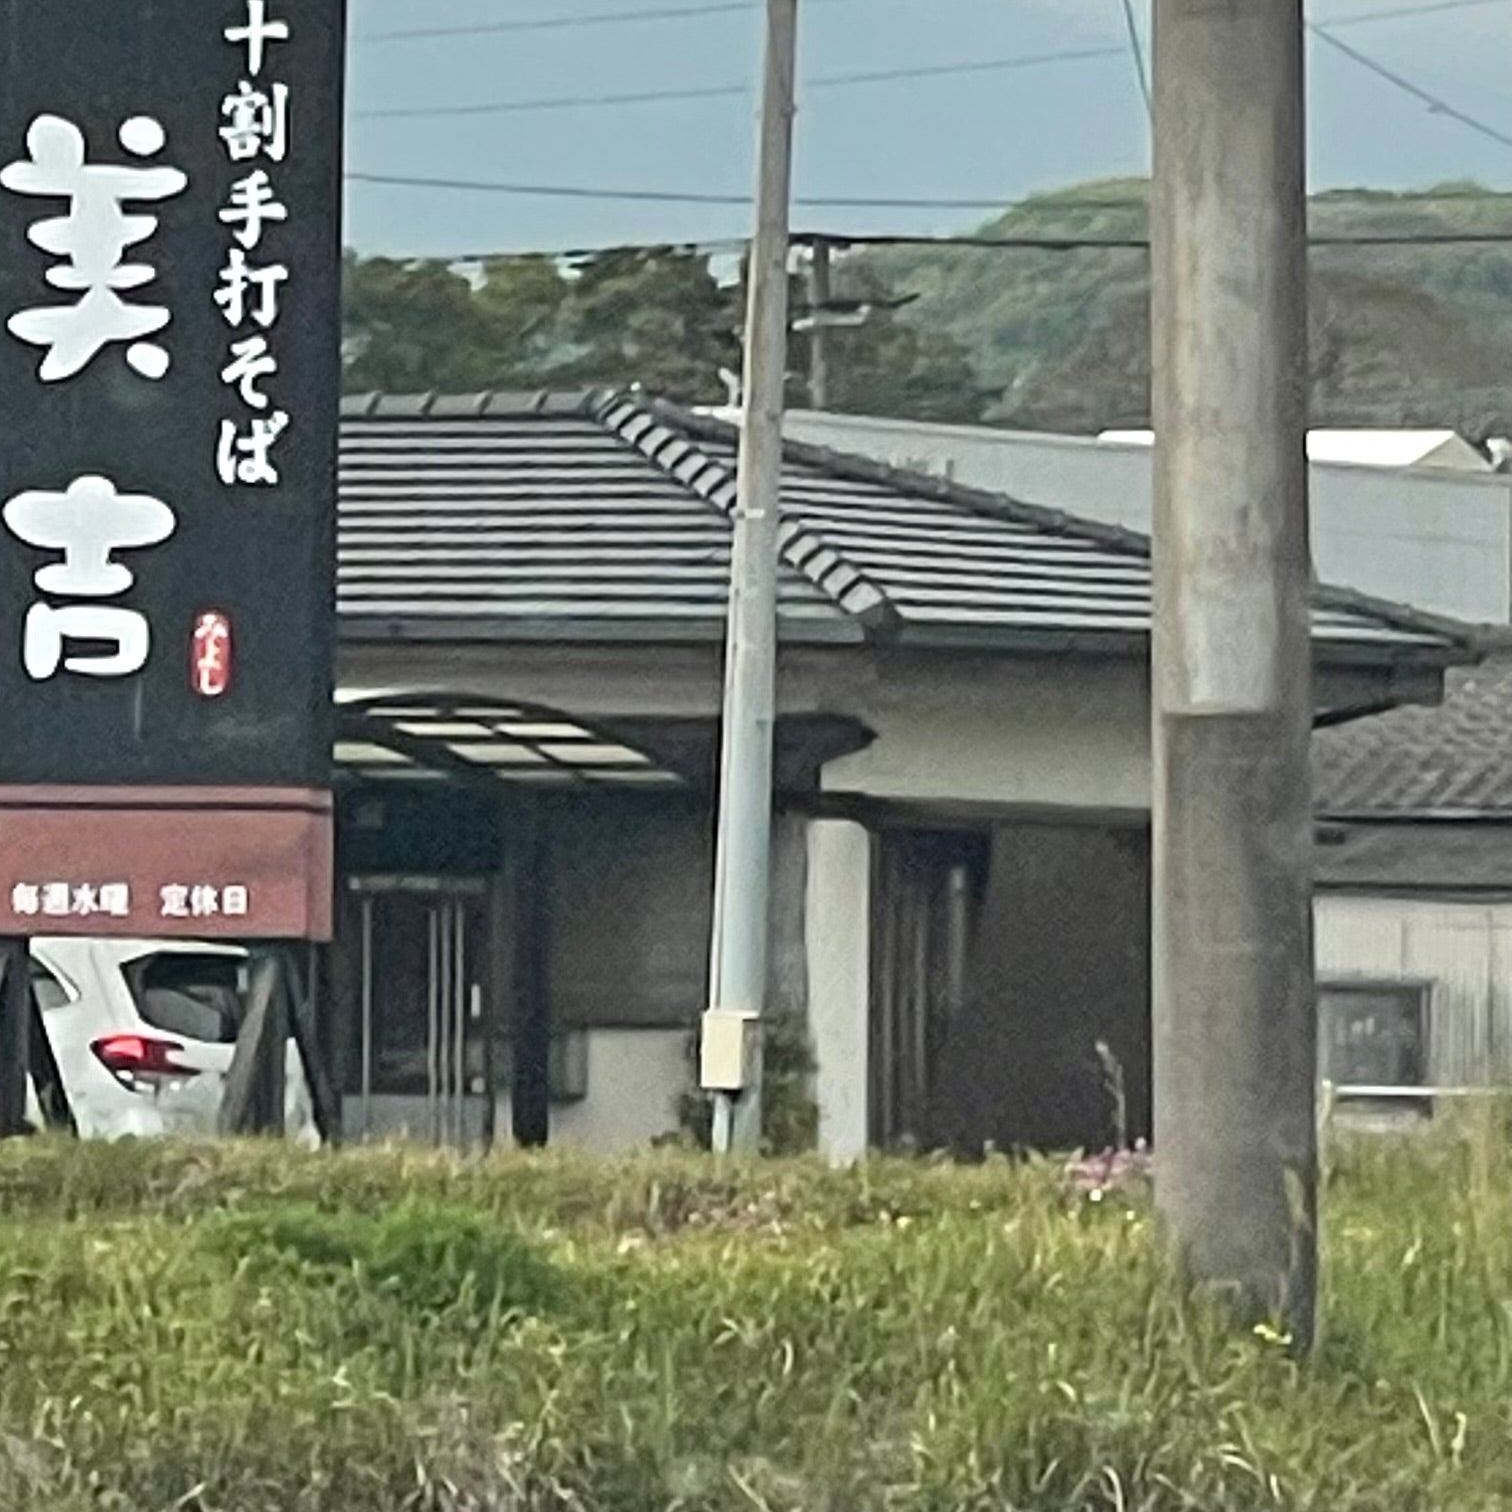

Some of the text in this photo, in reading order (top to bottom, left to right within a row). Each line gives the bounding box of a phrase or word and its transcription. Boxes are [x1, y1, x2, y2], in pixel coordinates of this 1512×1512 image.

[0, 115, 188, 678] 美吉
[214, 0, 288, 483] 十割手打そば
[161, 884, 246, 915] 定休日
